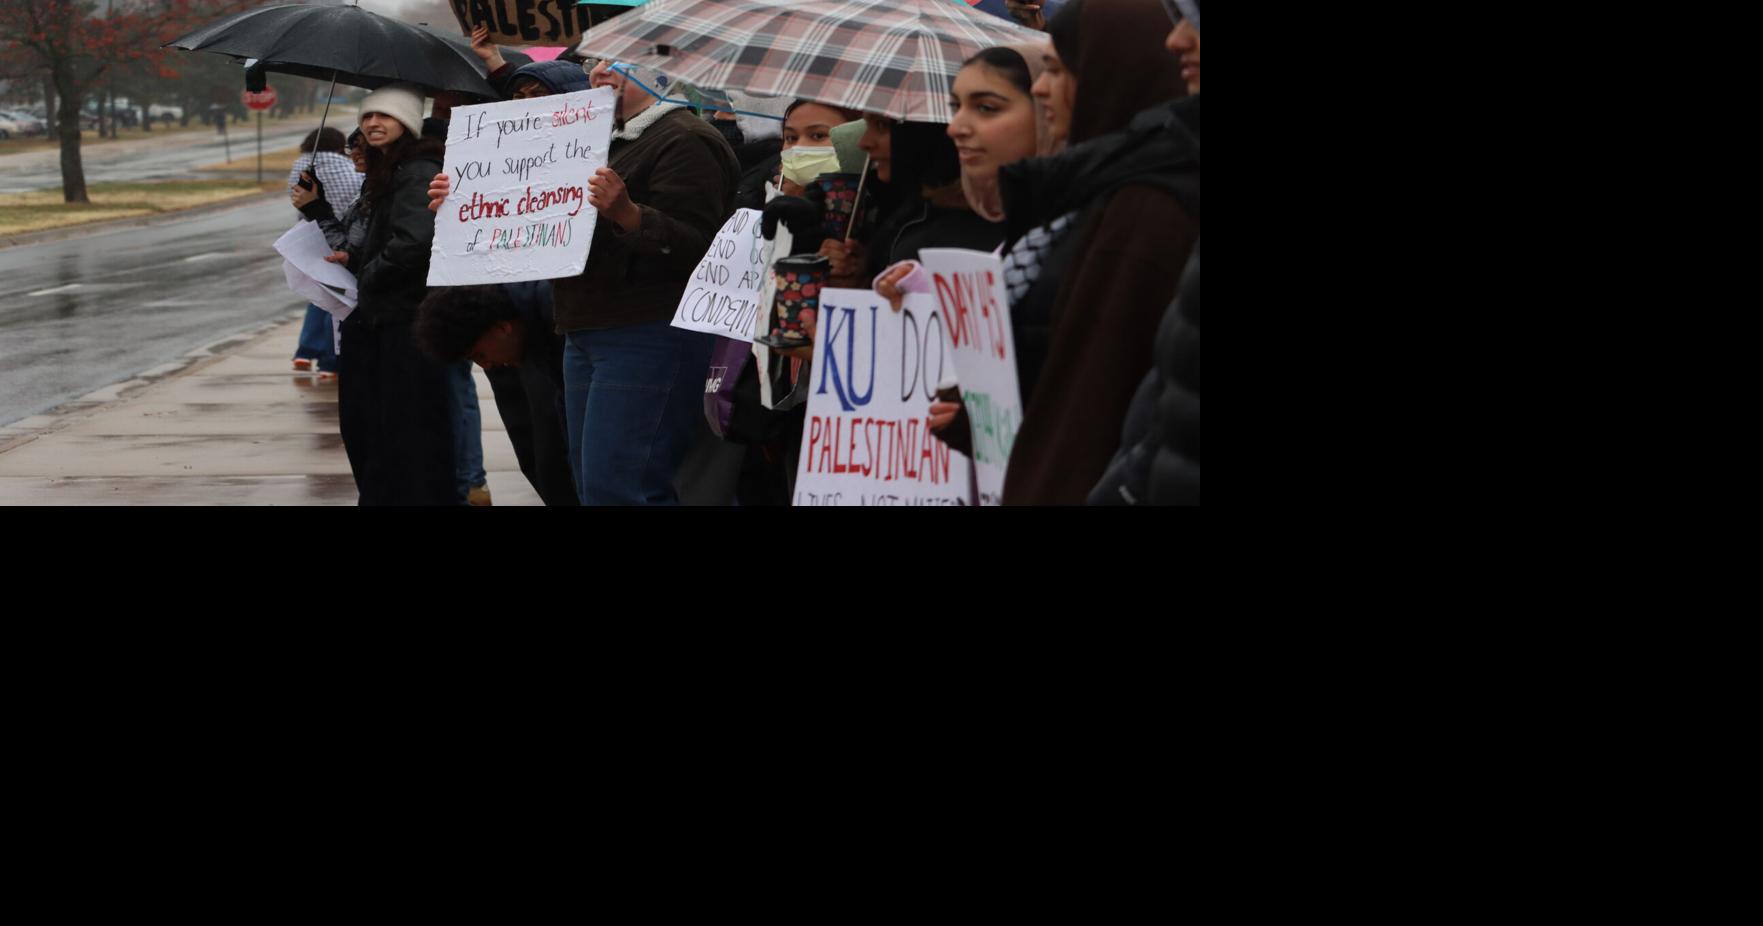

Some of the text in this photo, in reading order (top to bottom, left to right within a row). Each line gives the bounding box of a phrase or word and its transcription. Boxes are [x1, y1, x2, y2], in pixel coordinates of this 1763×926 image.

[464, 111, 486, 140] If
[552, 100, 598, 128] silent
[453, 138, 592, 192] you support the
[459, 185, 583, 223] ethnic cleansing
[467, 229, 483, 253] of
[697, 260, 730, 286] END
[933, 271, 982, 352] DAY
[816, 304, 879, 411] KU
[806, 416, 949, 484] PALESTINIAN
